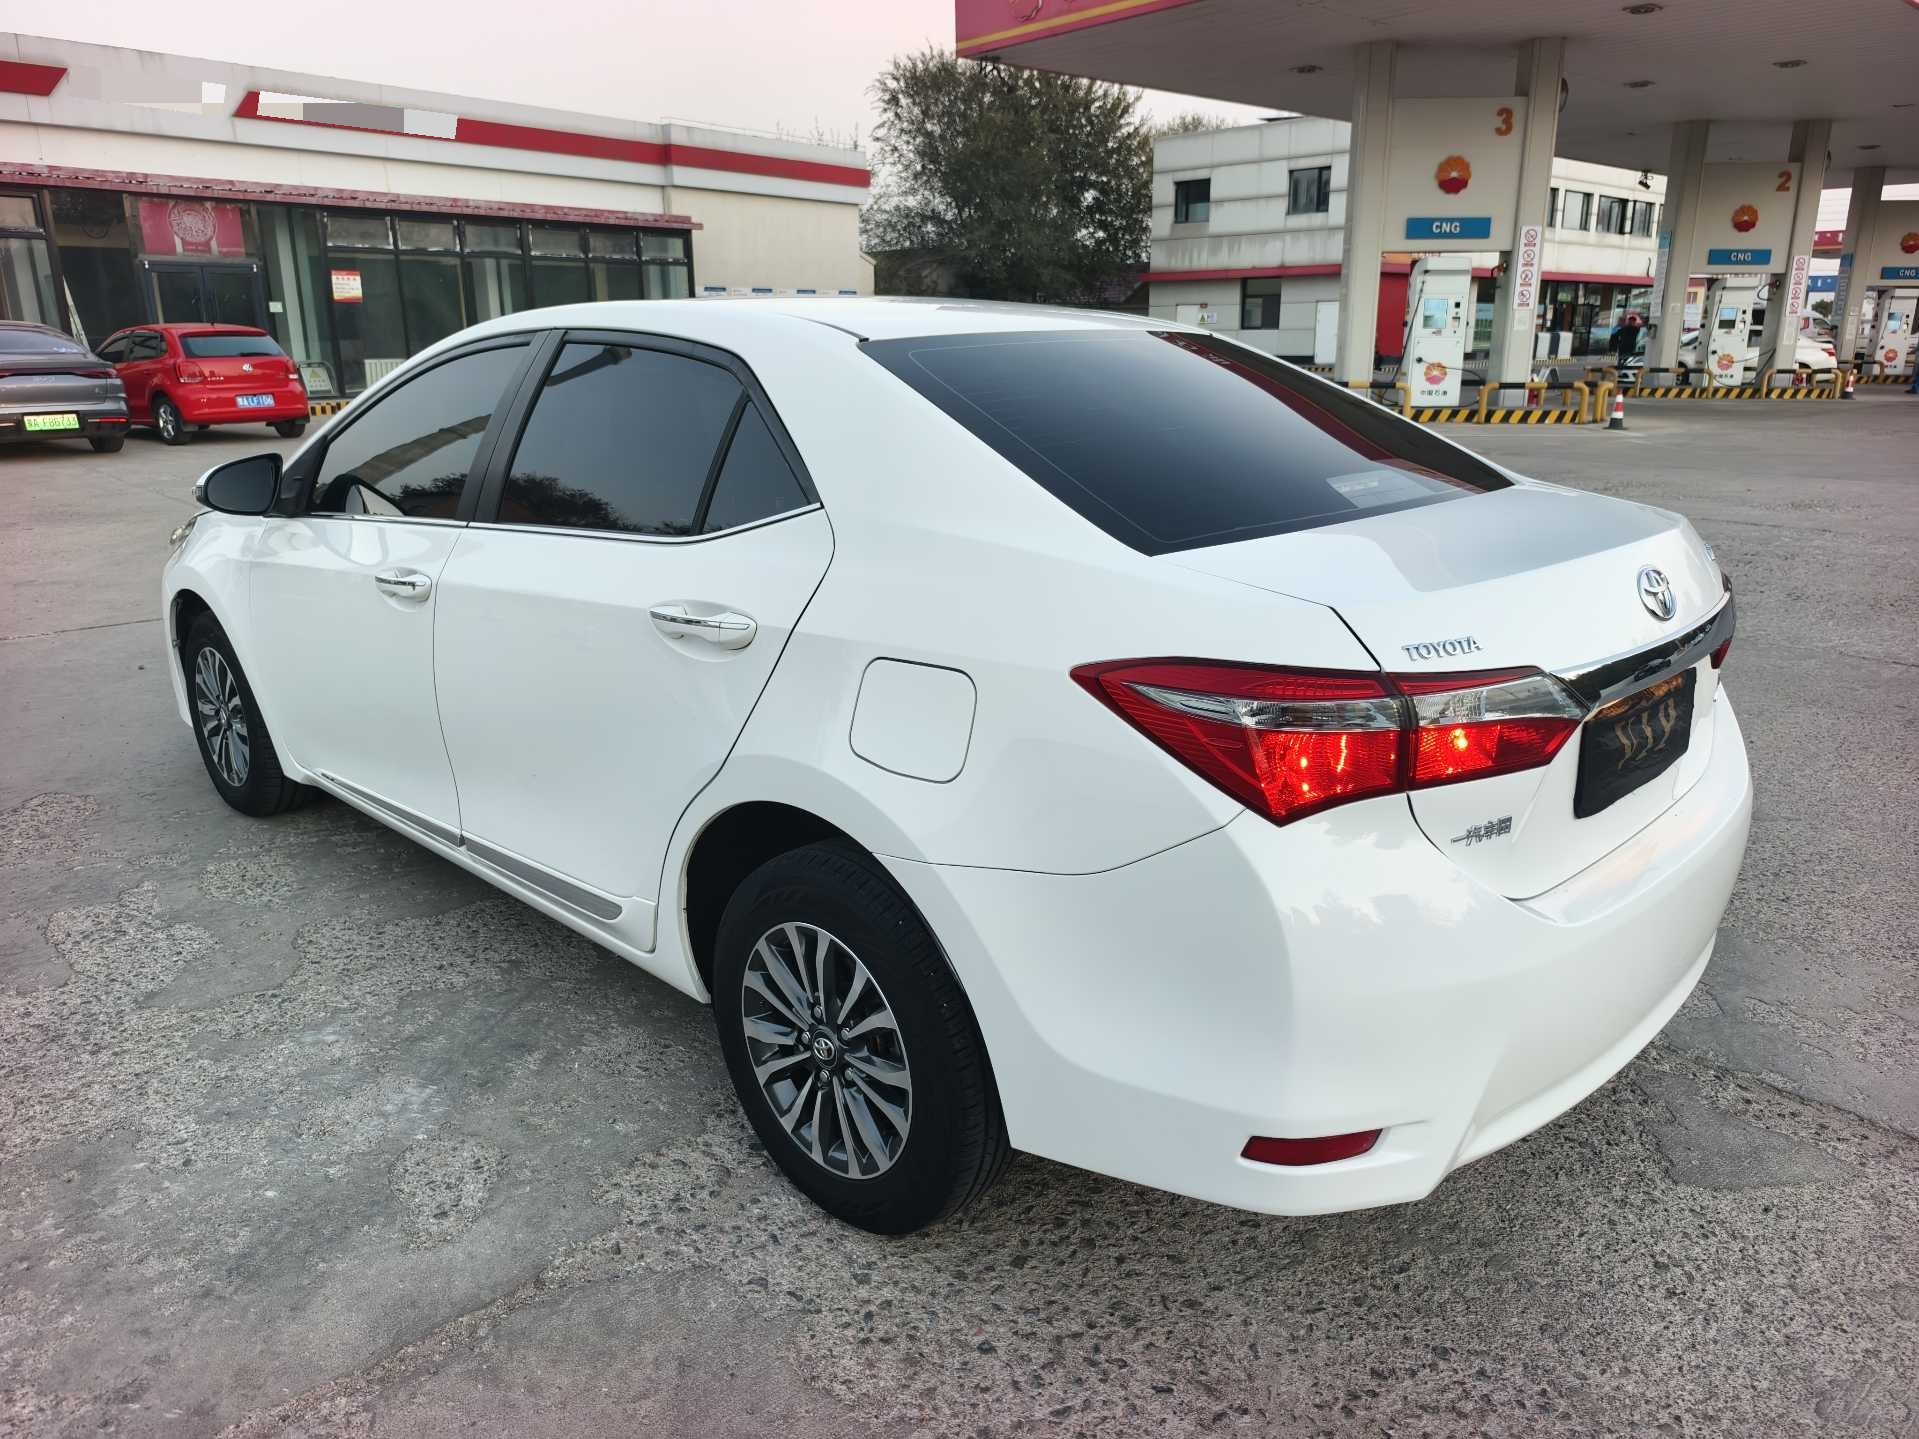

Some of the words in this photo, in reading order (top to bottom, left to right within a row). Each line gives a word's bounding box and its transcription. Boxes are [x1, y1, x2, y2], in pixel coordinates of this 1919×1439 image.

[1494, 107, 1513, 137] 3
[1775, 170, 1792, 192] 2
[1432, 222, 1461, 233] CNG
[1730, 252, 1752, 262] CNG
[1899, 269, 1916, 277] CNG
[1402, 636, 1483, 662] TOYOTA
